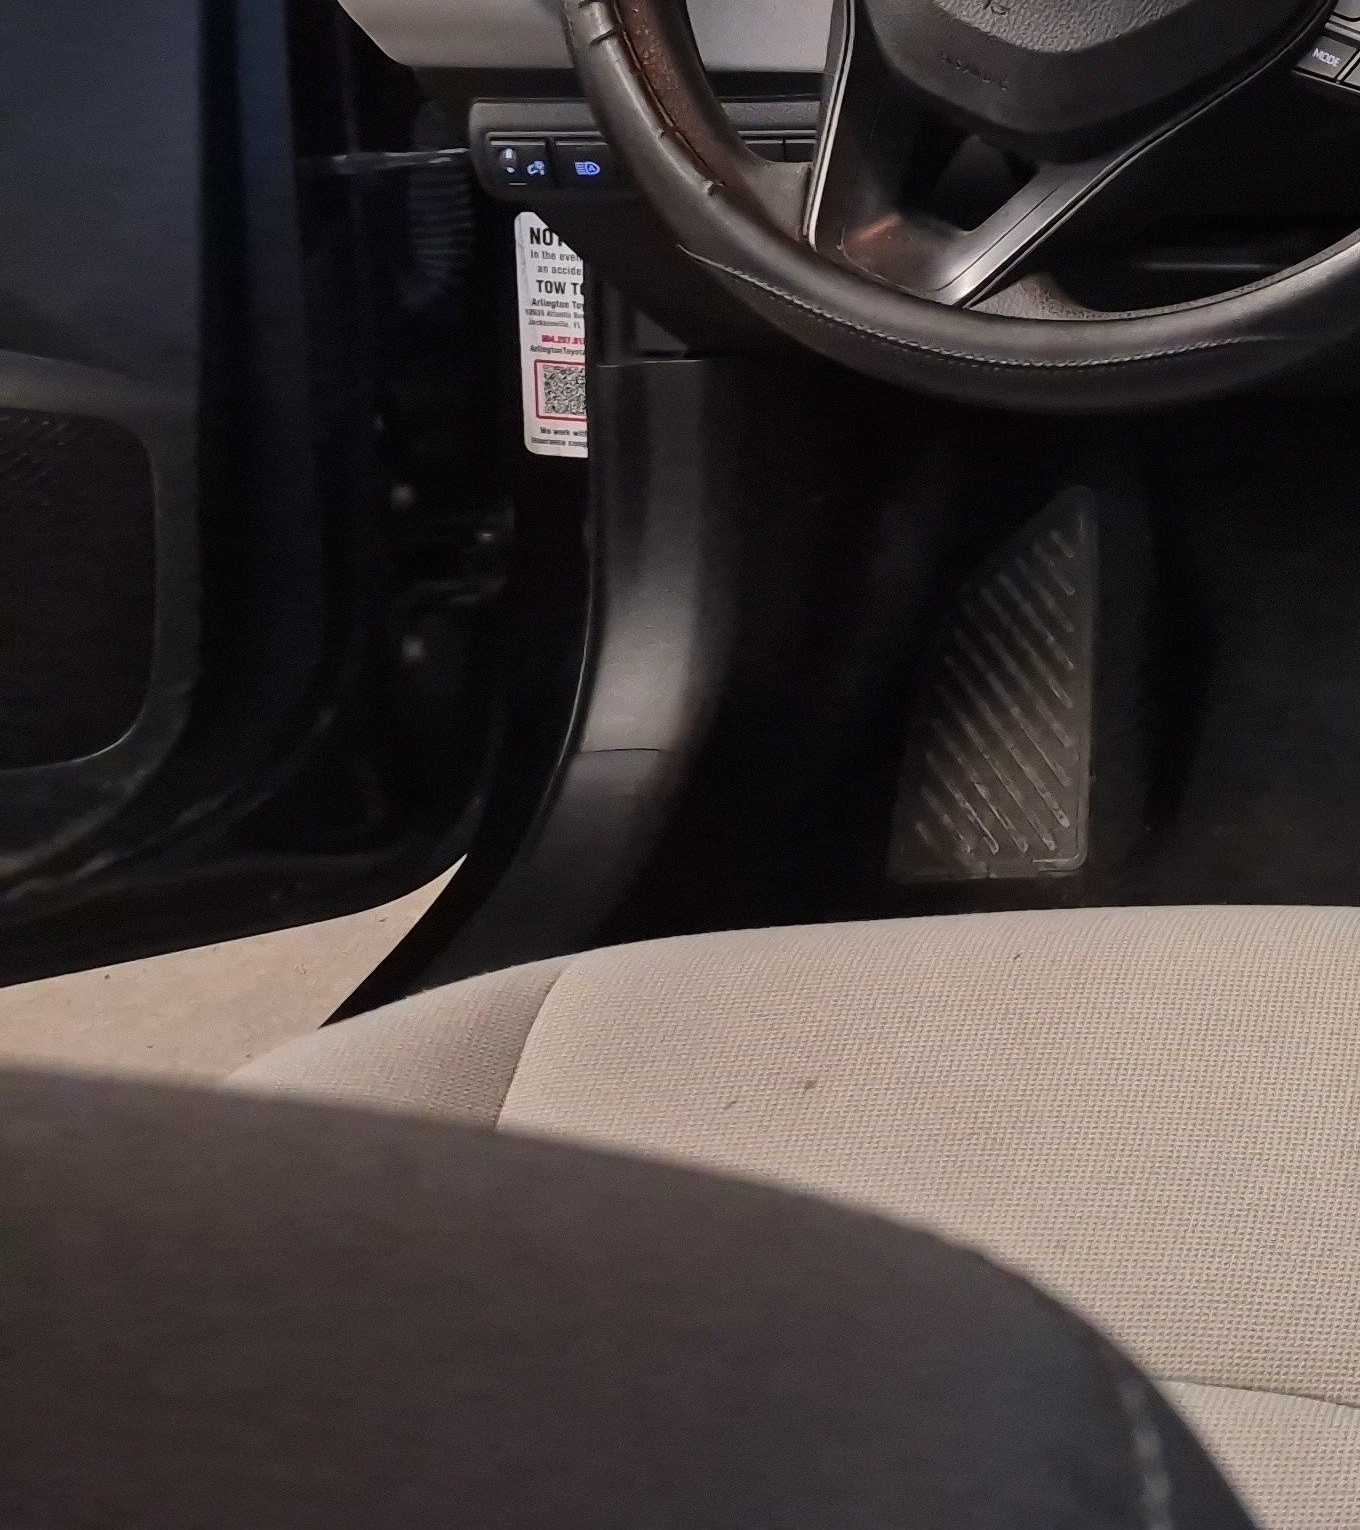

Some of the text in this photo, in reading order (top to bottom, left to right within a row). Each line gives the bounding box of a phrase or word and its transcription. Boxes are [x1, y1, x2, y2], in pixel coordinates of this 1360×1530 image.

[1312, 47, 1341, 68] MODE
[542, 251, 556, 260] the
[536, 279, 566, 295] TOW
